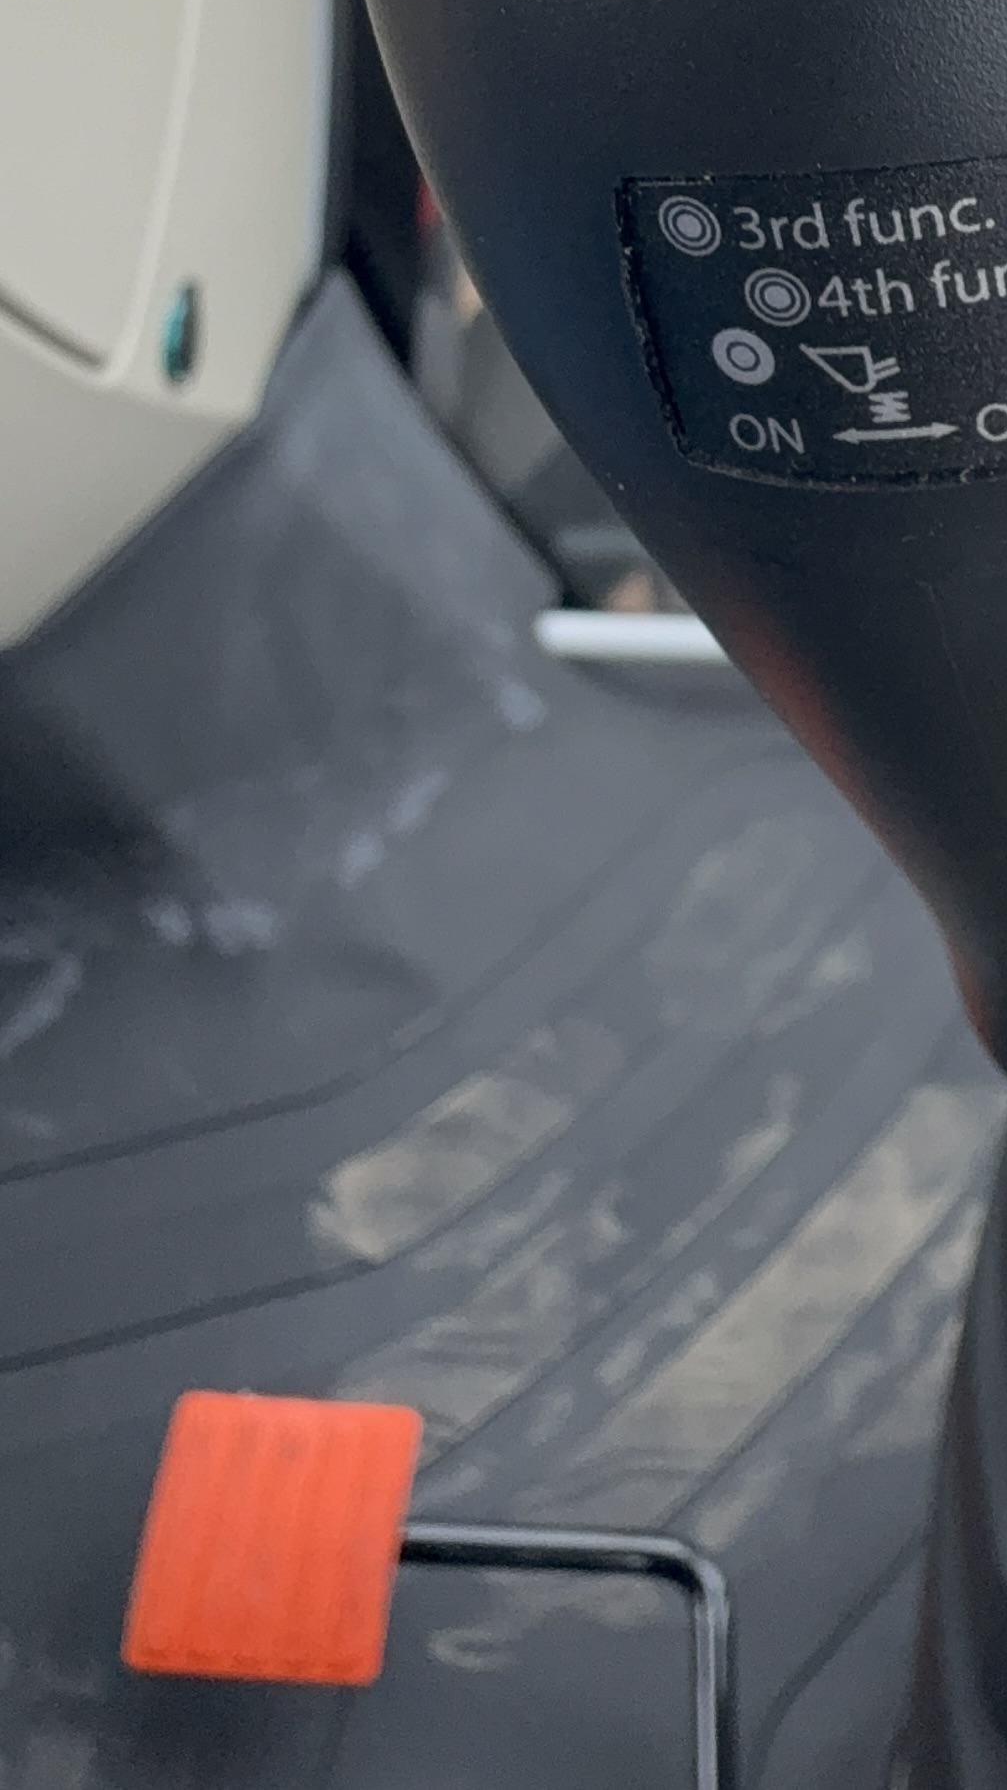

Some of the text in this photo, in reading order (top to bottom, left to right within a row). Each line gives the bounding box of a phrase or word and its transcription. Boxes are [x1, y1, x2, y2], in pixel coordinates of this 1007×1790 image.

[732, 197, 997, 251] 3rd func.
[818, 268, 915, 317] 4th
[729, 413, 806, 454] ON
